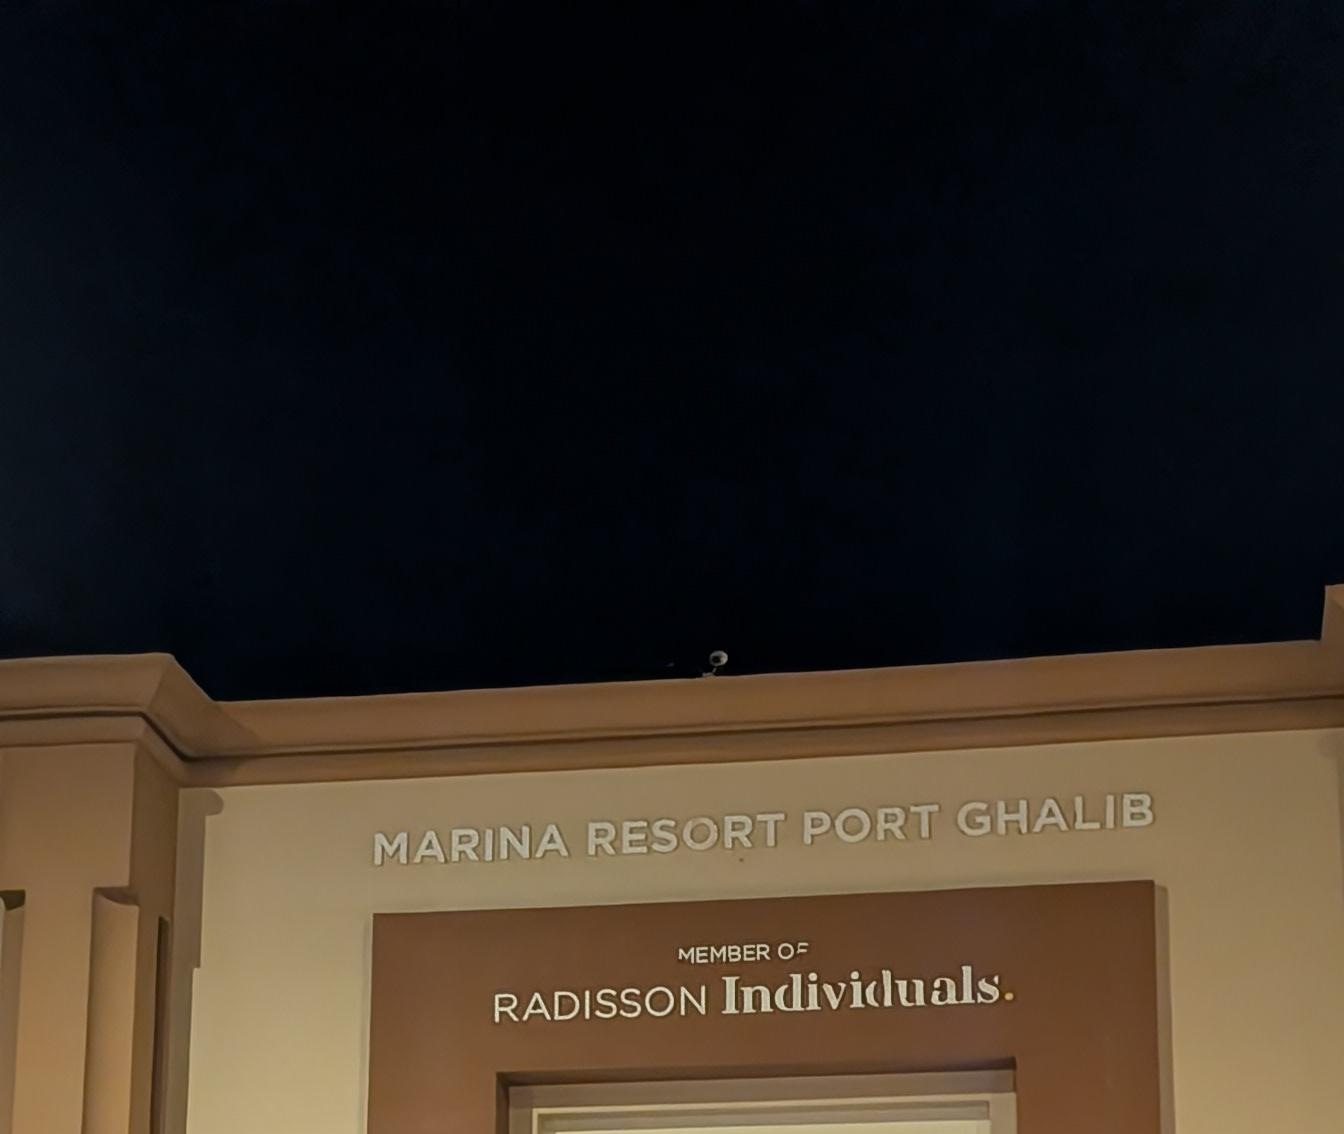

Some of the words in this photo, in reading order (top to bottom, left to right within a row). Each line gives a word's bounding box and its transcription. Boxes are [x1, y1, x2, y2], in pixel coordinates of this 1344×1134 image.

[373, 824, 570, 866] MARINA
[587, 813, 785, 857] RESORT
[803, 804, 939, 845] PORT
[957, 793, 1154, 837] GHALIB
[677, 944, 771, 964] MEMBER
[494, 985, 706, 1023] RADISSON
[721, 965, 1014, 1015] Individuals.
